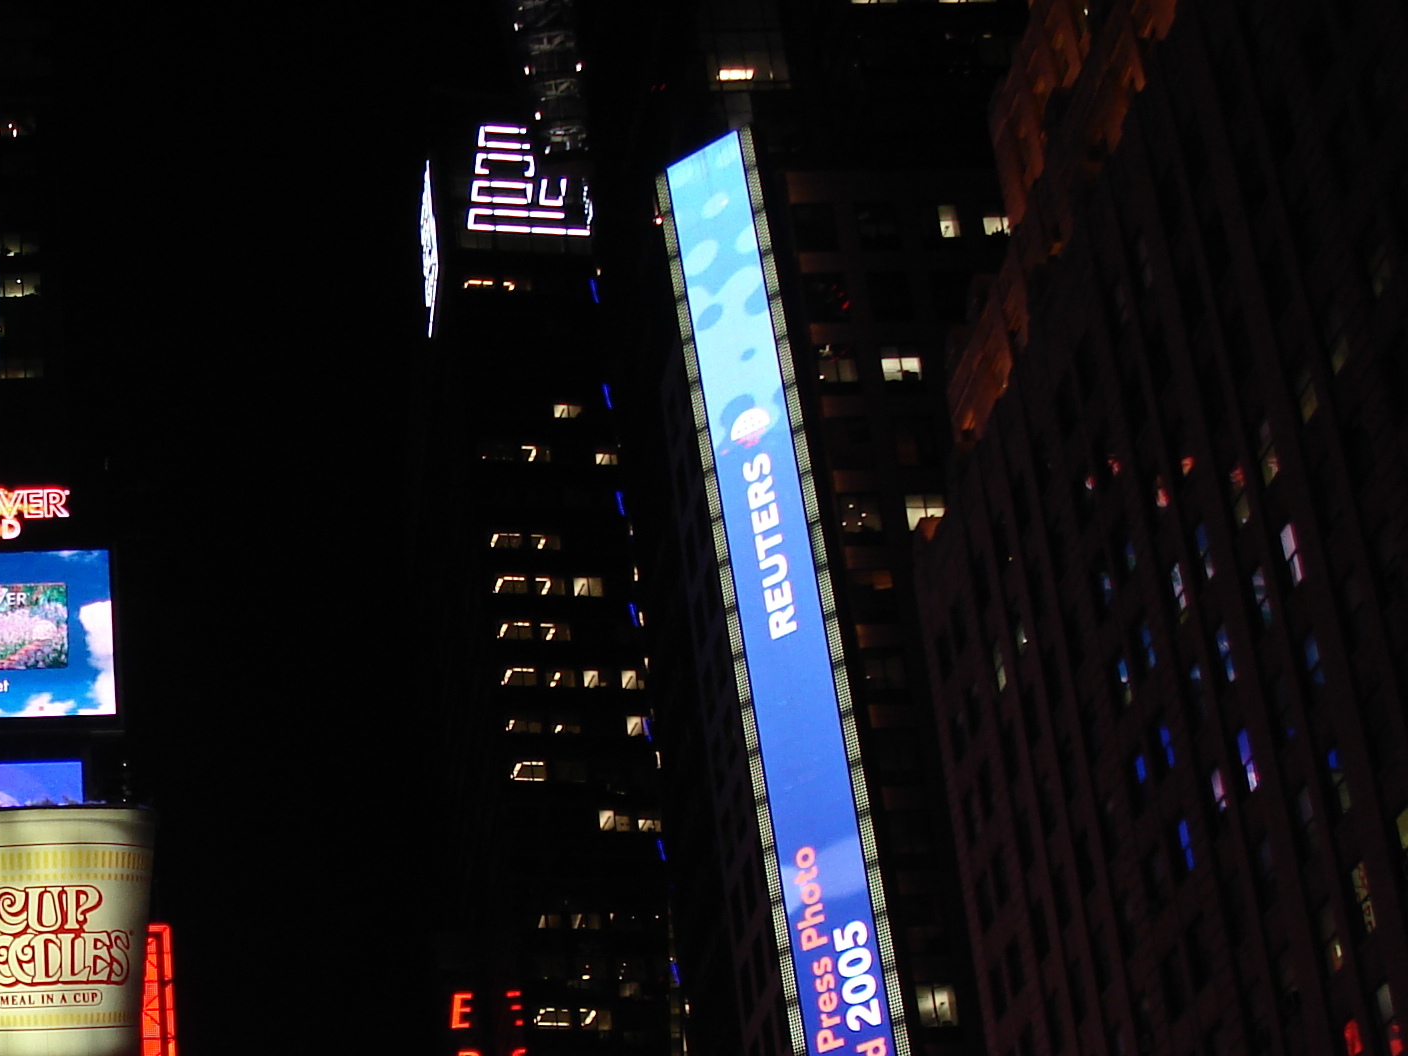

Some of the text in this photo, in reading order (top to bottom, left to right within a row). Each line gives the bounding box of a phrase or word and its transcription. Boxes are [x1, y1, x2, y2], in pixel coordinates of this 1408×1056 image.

[741, 453, 797, 640] REUTERS
[795, 846, 829, 951] Photo
[0, 992, 99, 1006] MEAL IN A CUP
[813, 956, 845, 1053] Press
[833, 920, 882, 1031] 2005
